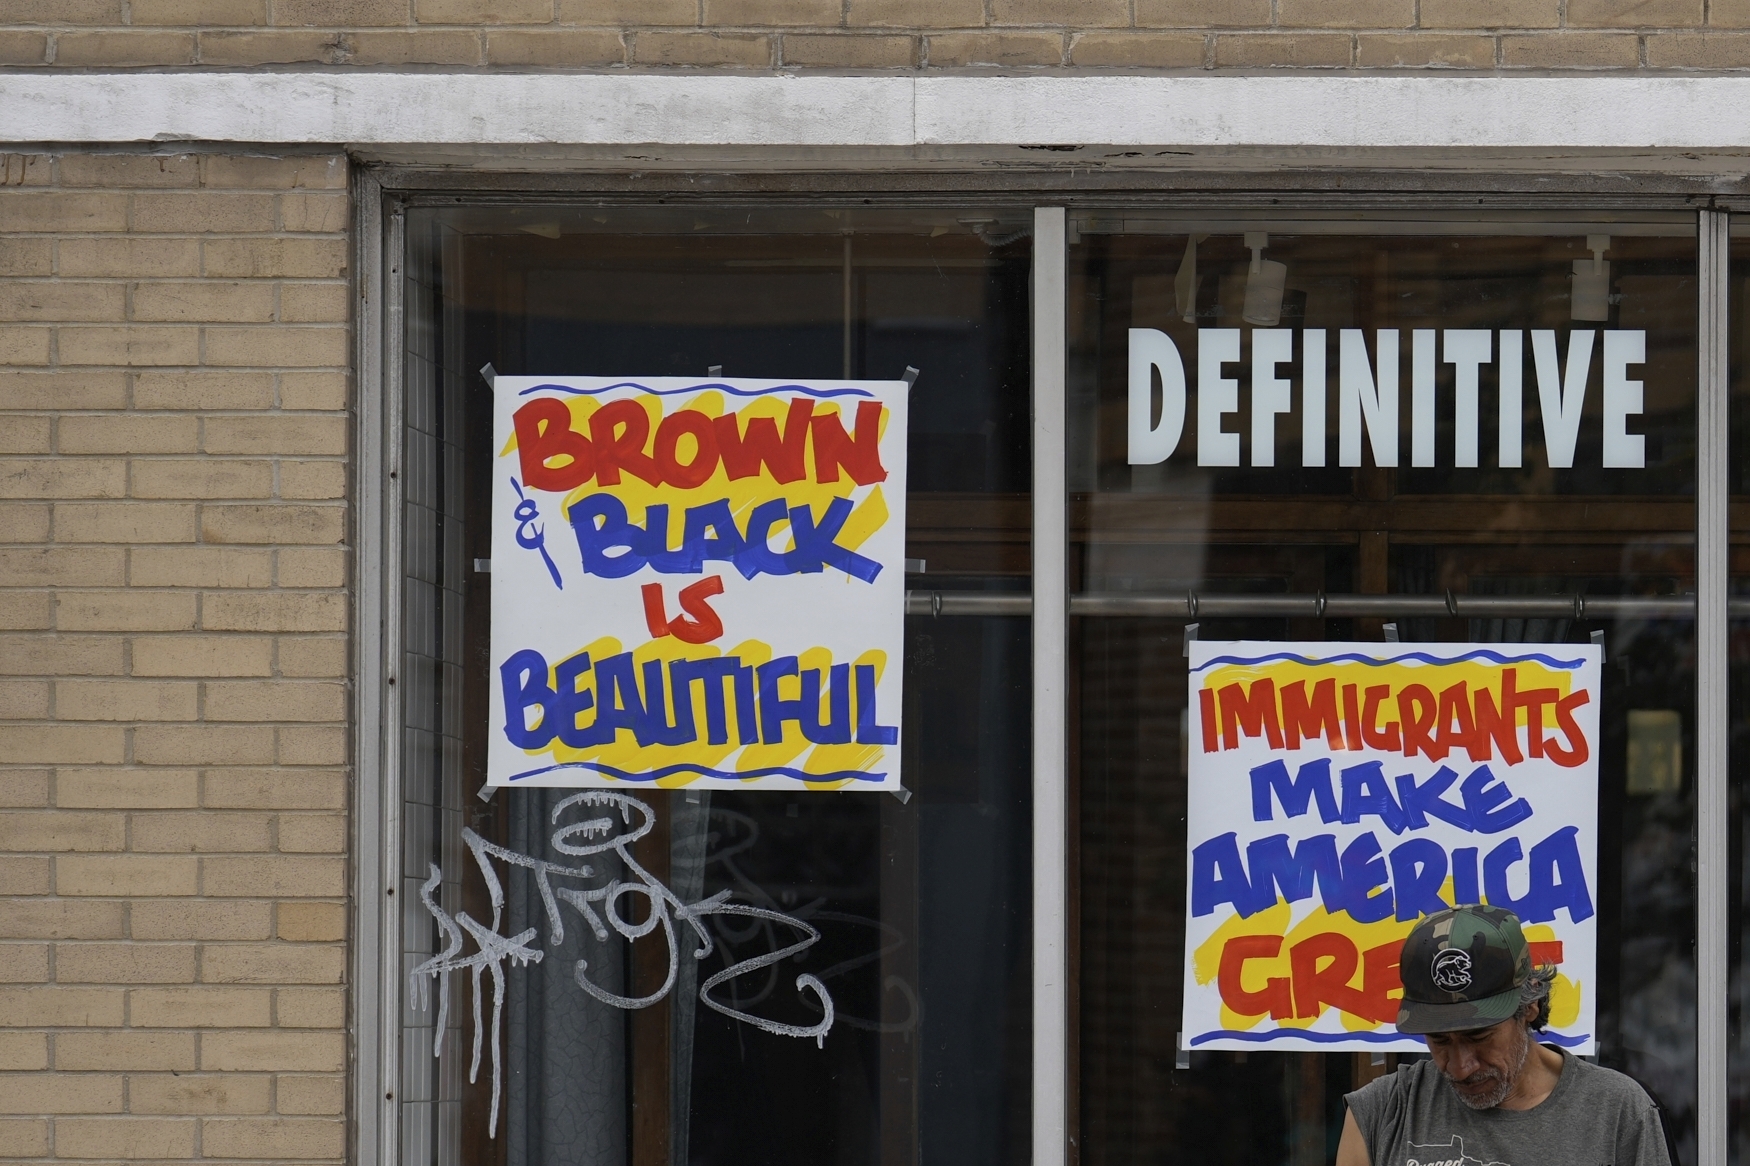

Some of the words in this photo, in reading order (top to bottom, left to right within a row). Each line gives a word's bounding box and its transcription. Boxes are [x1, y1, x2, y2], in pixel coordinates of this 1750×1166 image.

[512, 397, 889, 492] BROWN
[1127, 328, 1646, 469] DEFINITIVE
[510, 476, 563, 590] &
[568, 492, 883, 585] BLACK
[641, 575, 725, 645] IS
[500, 648, 898, 750] BEAUTIFUL
[1199, 667, 1590, 768] IMMIGRANTS
[1248, 757, 1534, 836] MAKE
[1190, 825, 1594, 924] AMERICA
[1217, 932, 1563, 1024] GRE
